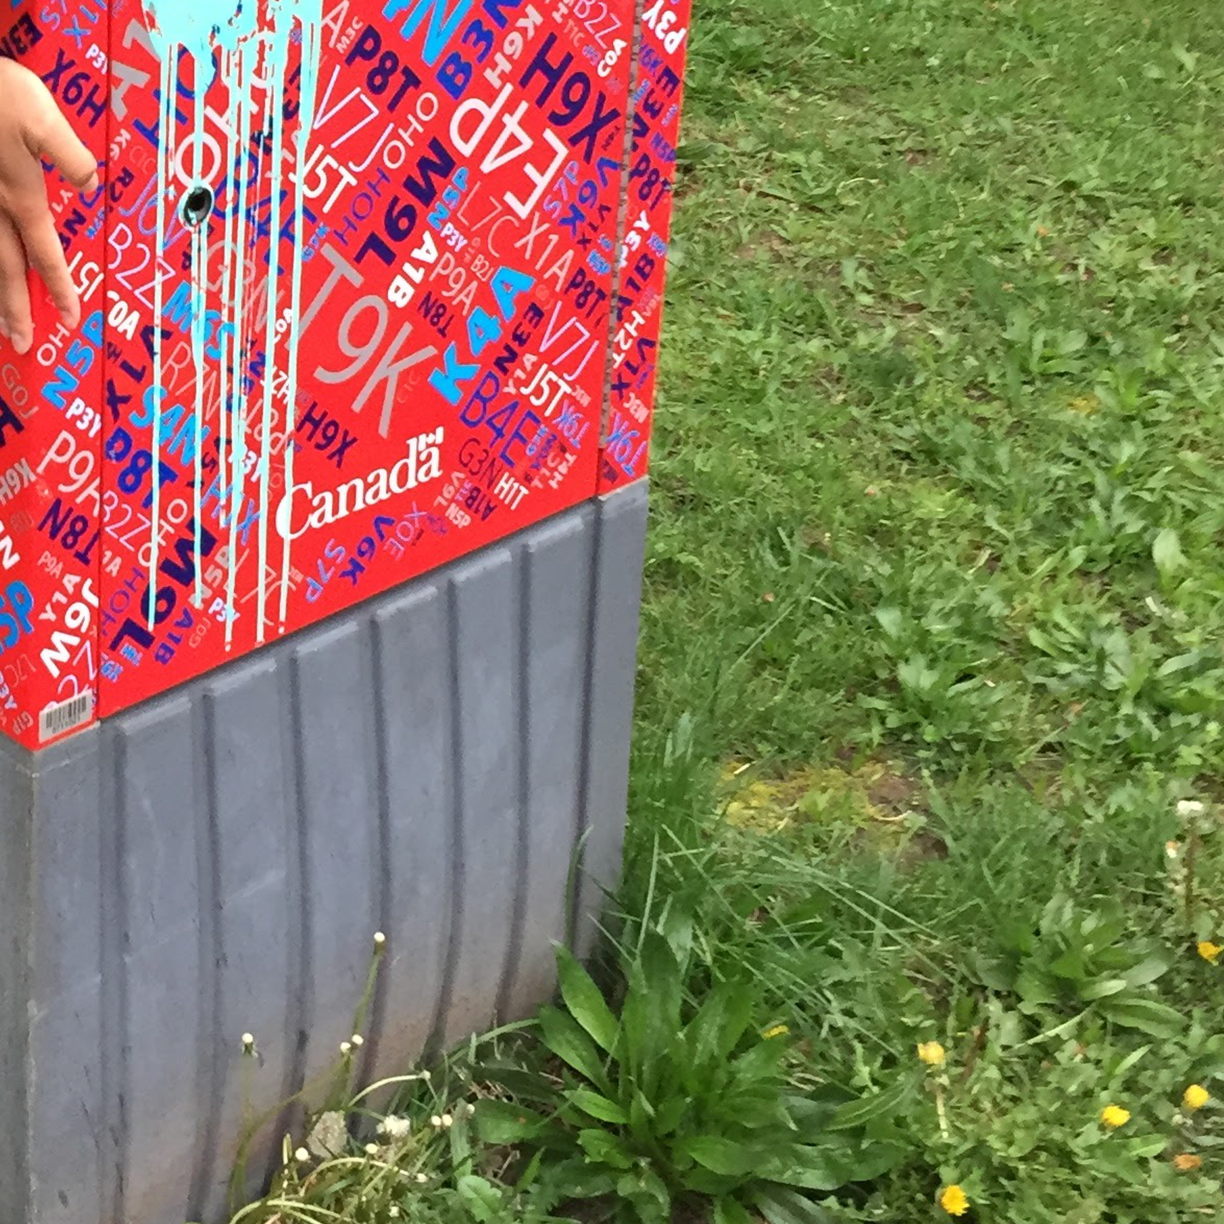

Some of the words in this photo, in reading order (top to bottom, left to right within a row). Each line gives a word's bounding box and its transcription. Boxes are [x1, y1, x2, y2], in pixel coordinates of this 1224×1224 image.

[335, 15, 364, 55] M3C
[344, 23, 423, 115] P8T
[518, 30, 622, 165] H9X
[542, 160, 579, 220] S7P
[439, 221, 469, 253] P3Y
[513, 206, 575, 293] X1A
[428, 251, 479, 316] P9A
[565, 267, 607, 320] P8T
[427, 265, 537, 407] K4A
[502, 351, 539, 396] Y1A
[519, 362, 573, 418] J5T
[64, 397, 103, 439] P3Y
[295, 400, 359, 470] H9X
[459, 368, 542, 470] B4E
[275, 433, 444, 541] Canada
[493, 471, 530, 511] H1T
[38, 572, 82, 623] Y1A
